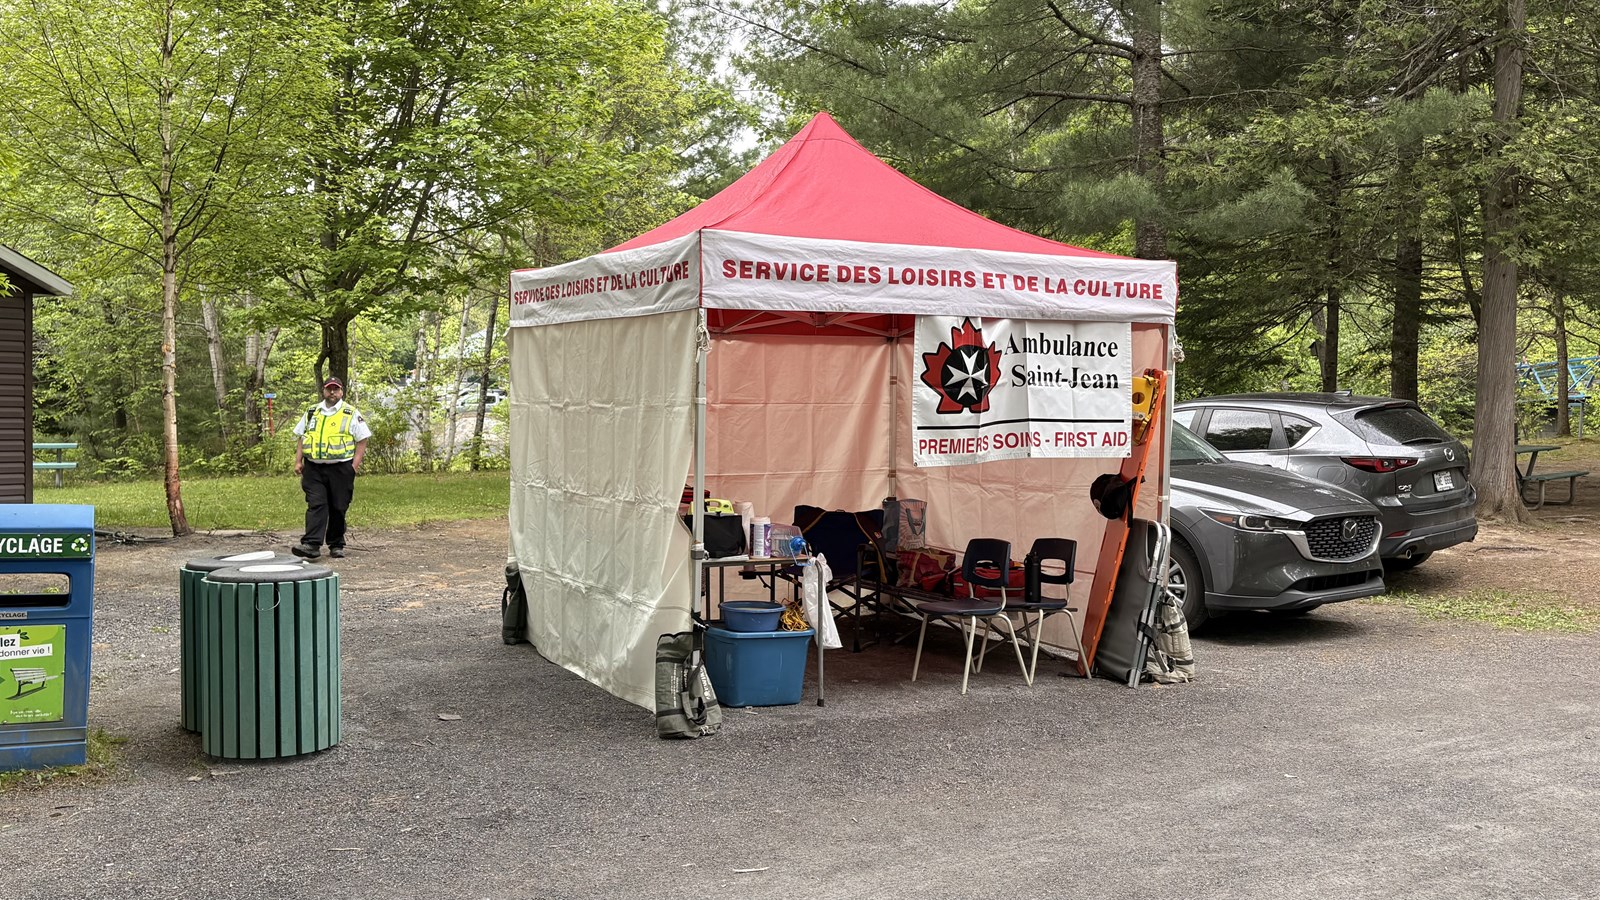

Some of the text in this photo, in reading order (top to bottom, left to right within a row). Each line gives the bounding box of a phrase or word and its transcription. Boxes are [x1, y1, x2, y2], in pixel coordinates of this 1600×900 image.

[514, 261, 688, 305] SERVICE DES LOISIRS ET DE LA CULTURE
[722, 259, 1163, 299] SERVICE DES LOISIRS ET DE LA CULTURE
[1004, 332, 1119, 358] Ambulance
[1011, 364, 1119, 389] Saint-Jean
[919, 435, 989, 454] PREMIERS
[992, 431, 1041, 449] SOINS
[1054, 431, 1097, 447] FIRST
[1101, 431, 1128, 447] AID
[0, 649, 30, 658] donner
[32, 646, 45, 655] vie
